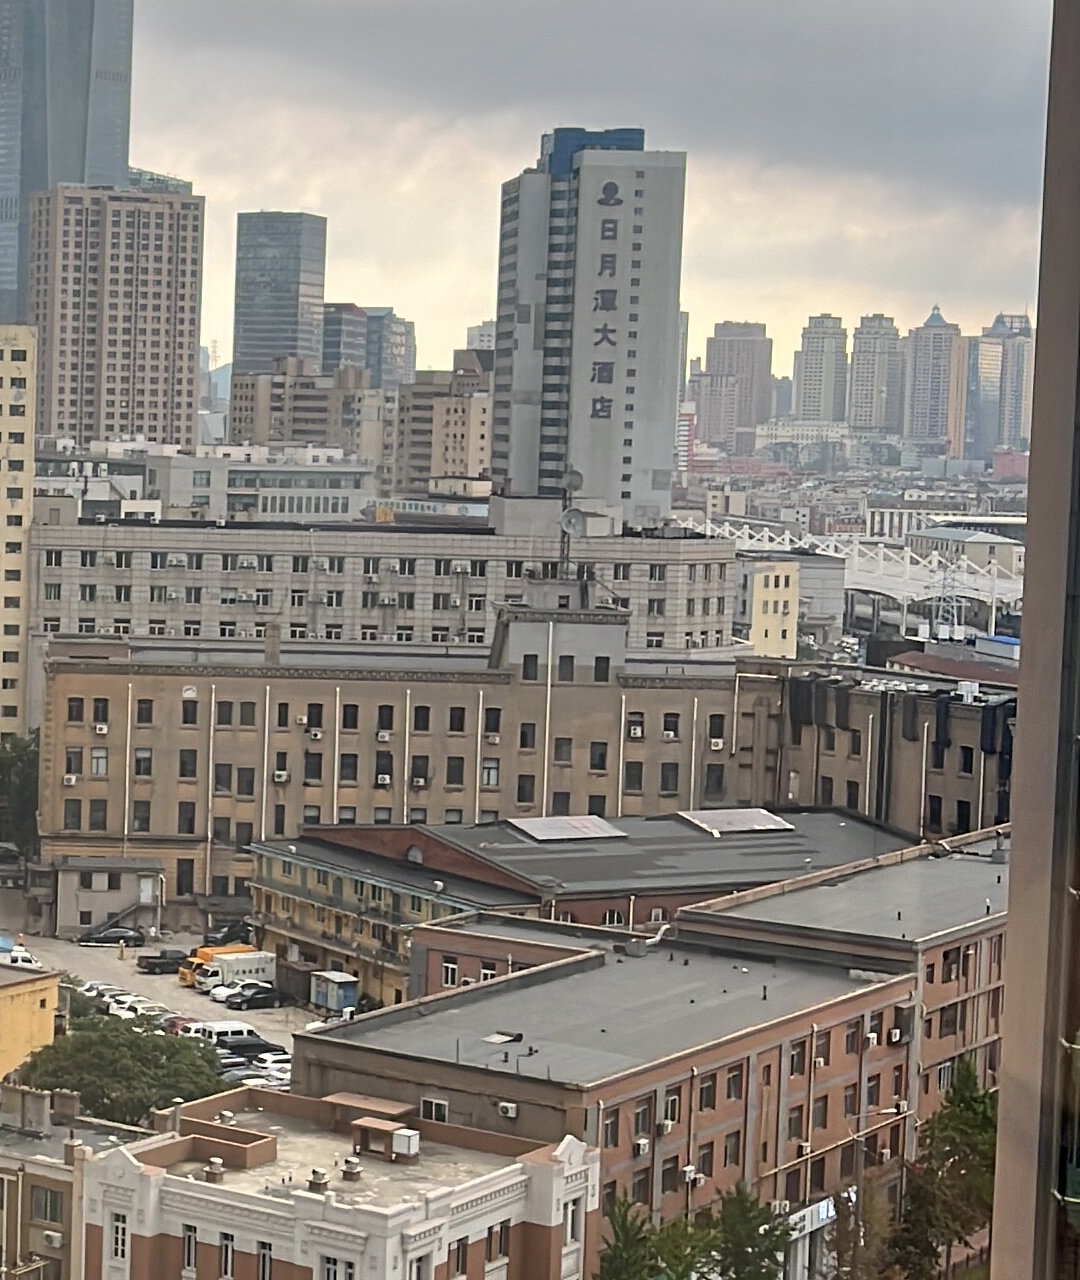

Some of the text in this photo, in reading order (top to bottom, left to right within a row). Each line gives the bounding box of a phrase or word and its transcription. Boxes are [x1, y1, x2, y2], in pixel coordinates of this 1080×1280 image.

[590, 218, 619, 420] 日月潭大酒店
